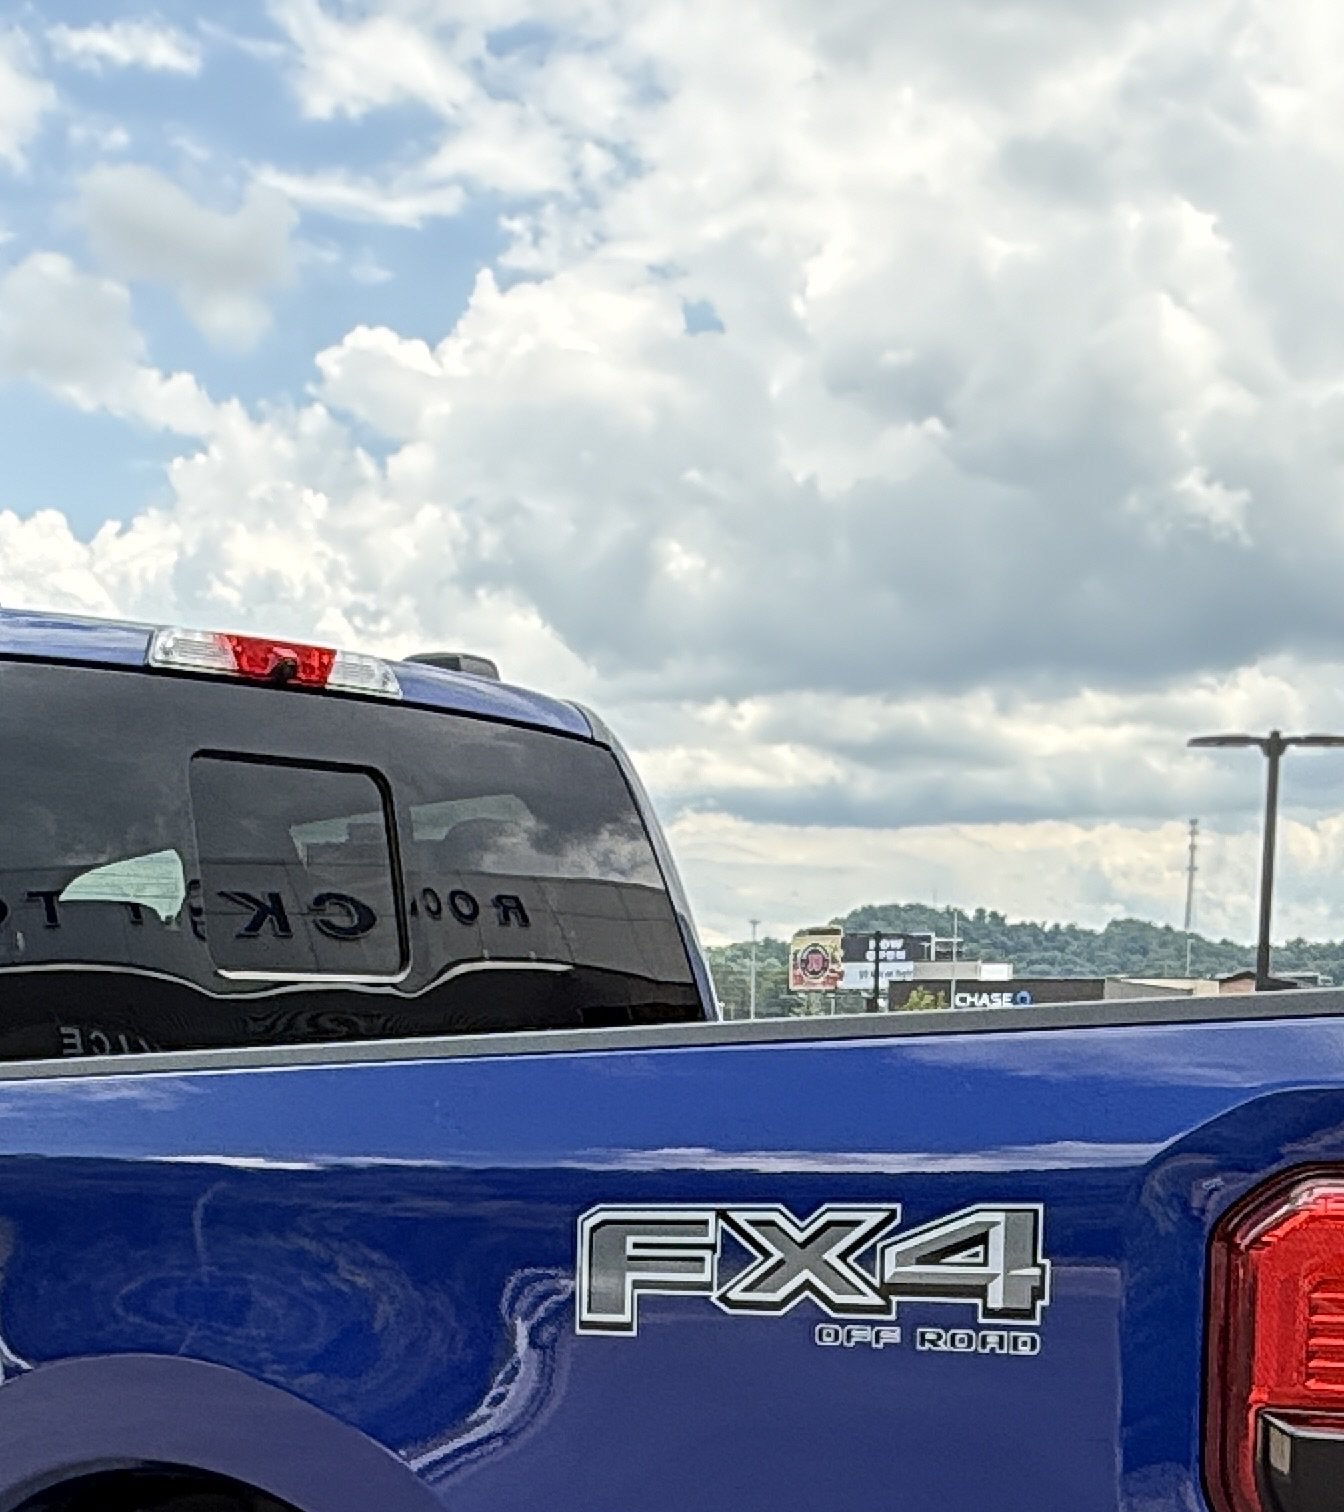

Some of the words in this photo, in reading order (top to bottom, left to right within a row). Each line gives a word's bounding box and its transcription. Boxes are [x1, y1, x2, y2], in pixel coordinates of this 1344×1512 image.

[955, 992, 1014, 1007] CHASE
[575, 1202, 1052, 1338] FX4
[813, 1322, 902, 1349] OFF
[915, 1326, 1042, 1357] ROAD
